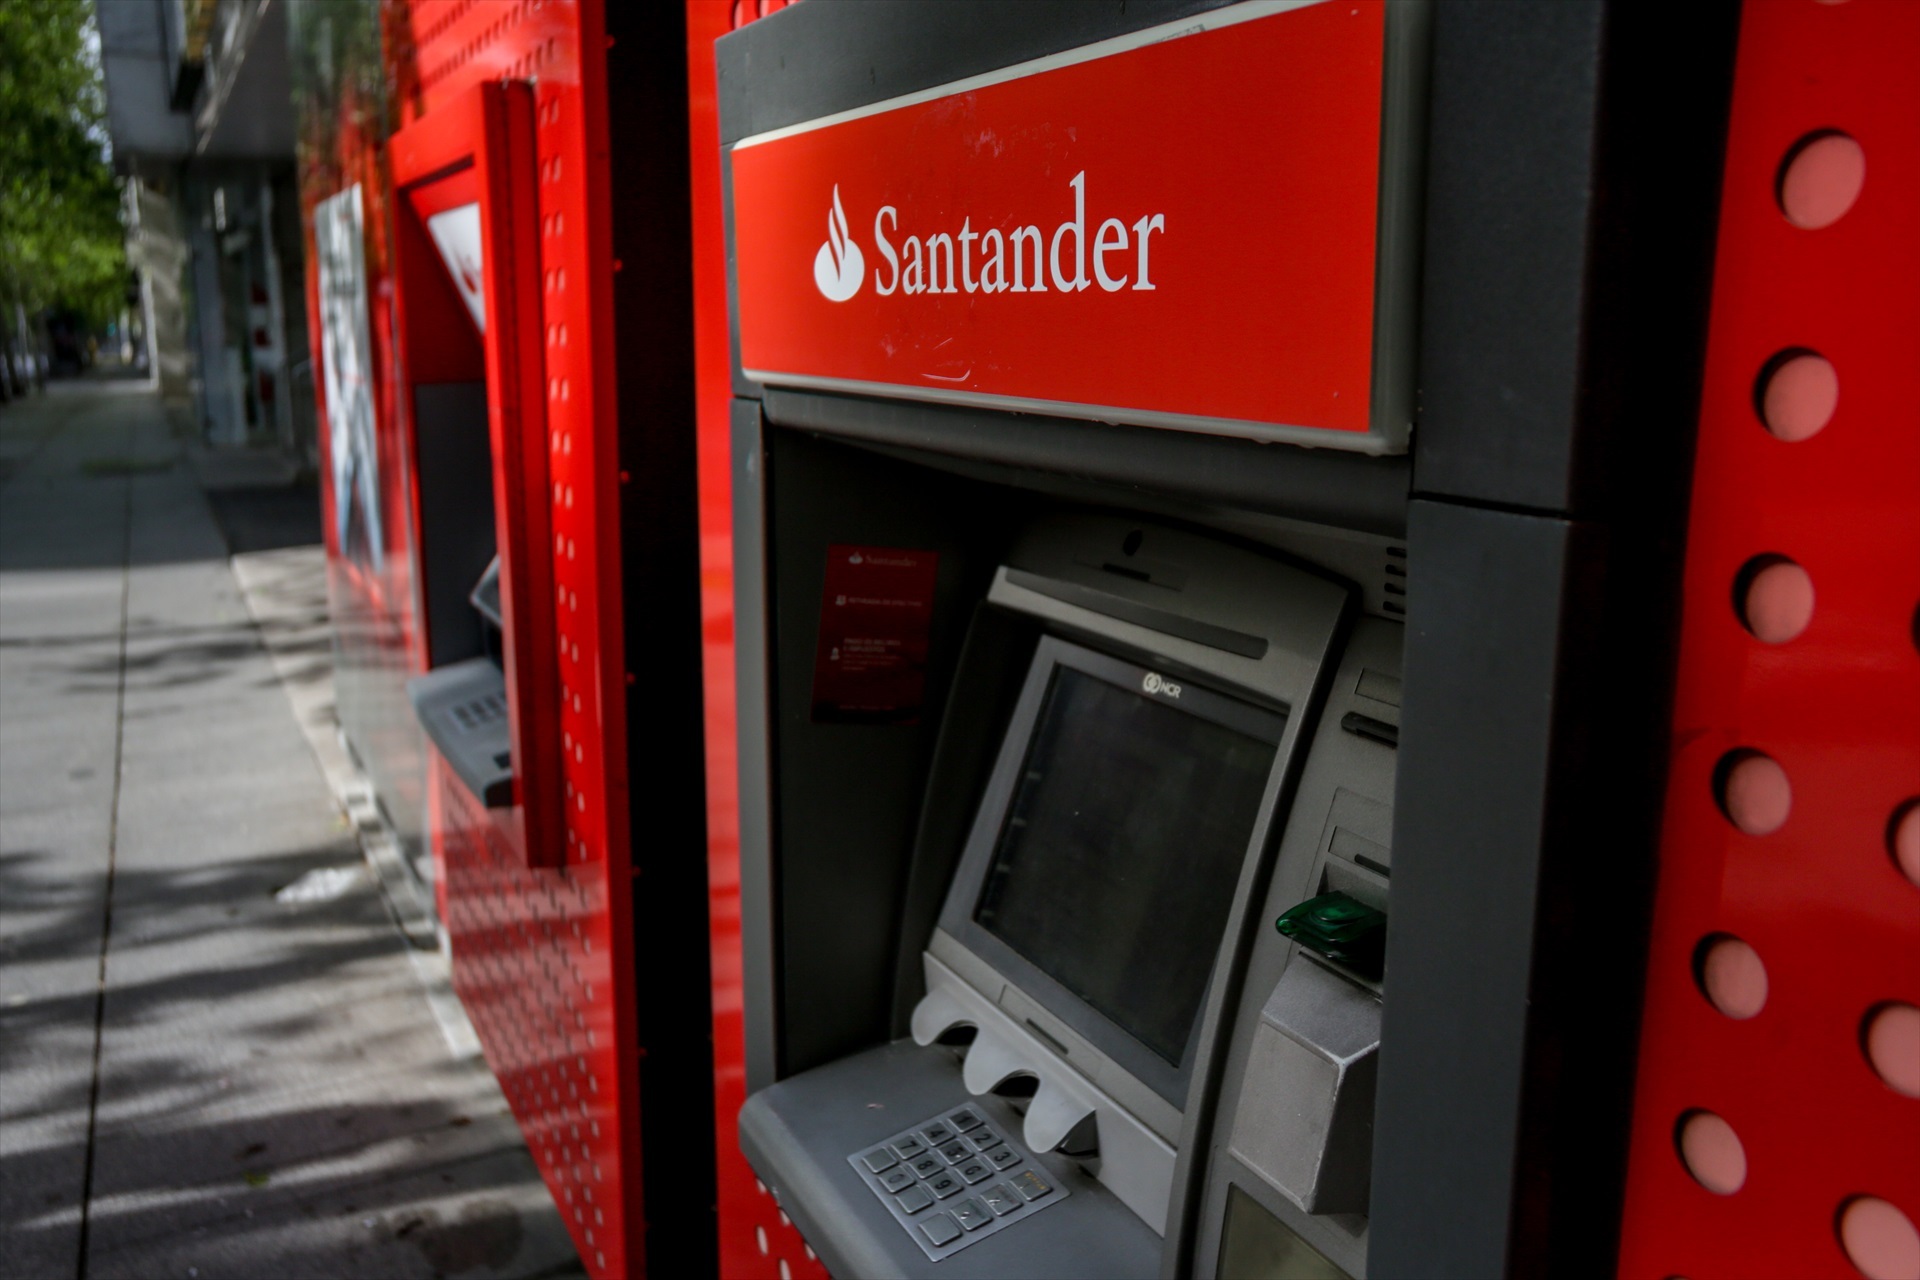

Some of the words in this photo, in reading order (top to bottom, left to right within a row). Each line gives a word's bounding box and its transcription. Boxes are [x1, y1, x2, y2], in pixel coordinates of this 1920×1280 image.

[874, 170, 1165, 296] Santander
[1160, 681, 1182, 699] NCR
[957, 1115, 973, 1125] 1
[929, 1130, 945, 1139] 4
[973, 1133, 992, 1144] 2
[900, 1140, 918, 1150] 7
[946, 1146, 964, 1157] 5
[994, 1151, 1011, 1163] 3
[917, 1160, 934, 1171] 8
[964, 1165, 982, 1176] 6
[934, 1179, 951, 1190] 9
